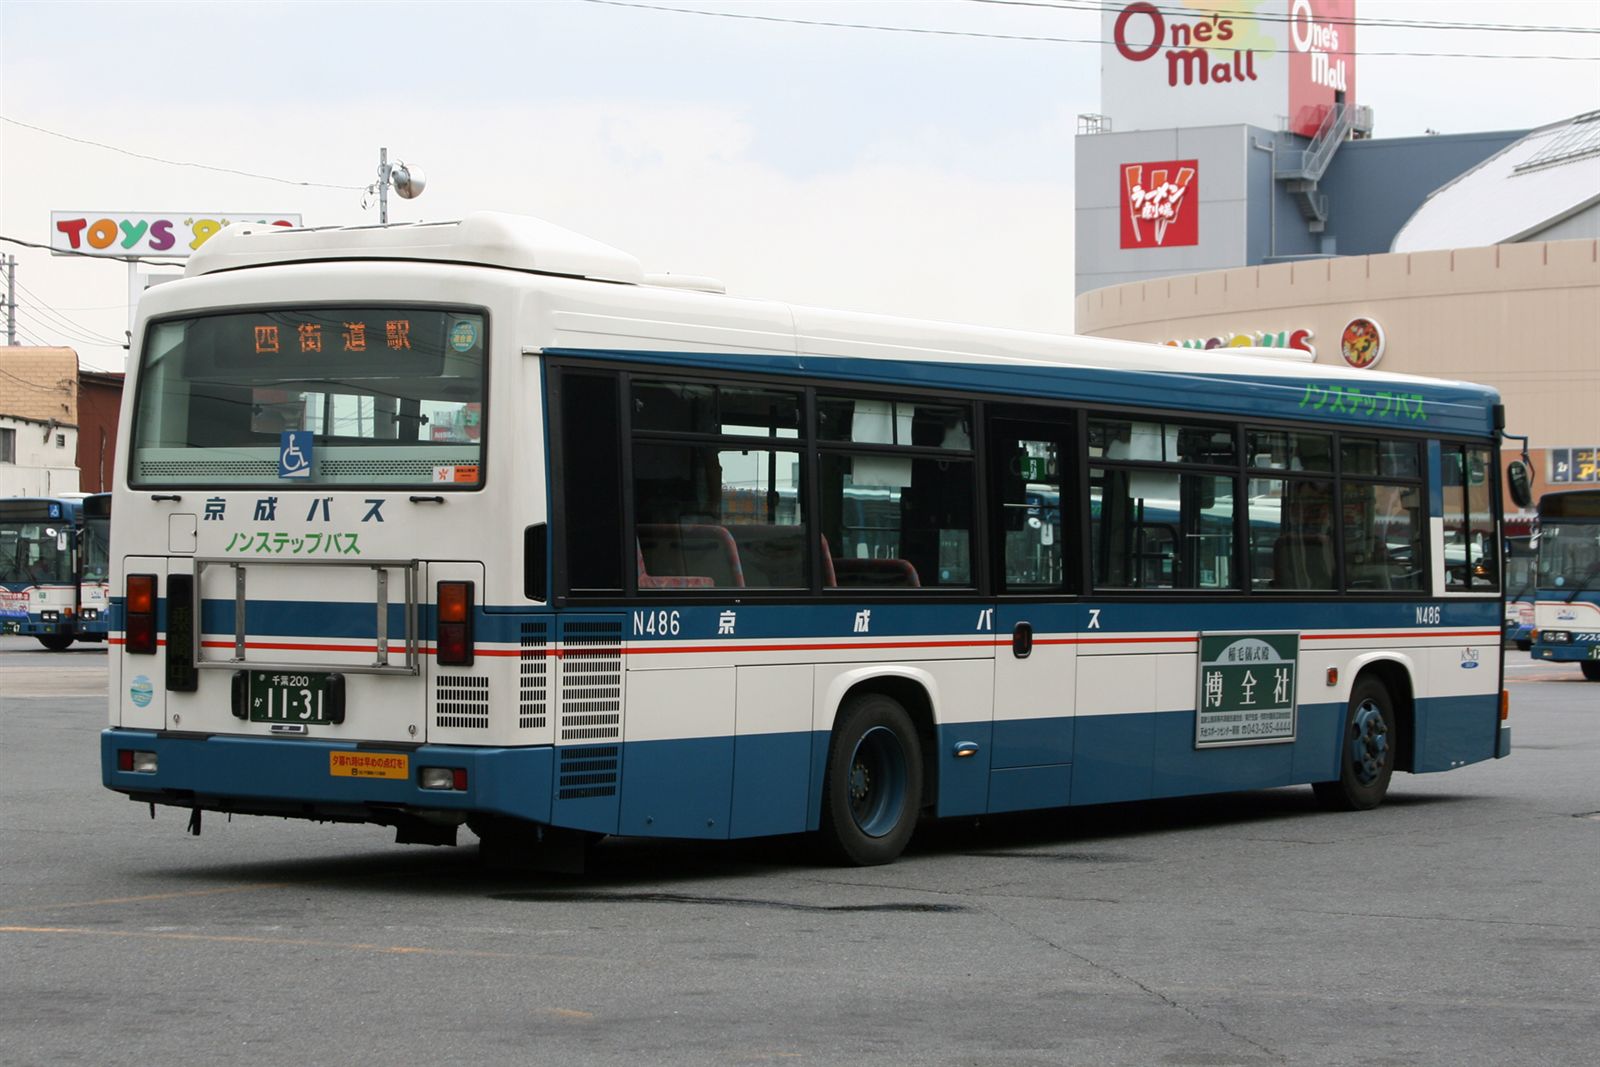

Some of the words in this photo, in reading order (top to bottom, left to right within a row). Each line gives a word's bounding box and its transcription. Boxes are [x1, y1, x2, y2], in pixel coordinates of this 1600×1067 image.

[1114, 2, 1233, 62] One's
[1291, 0, 1338, 53] One's
[1131, 182, 1185, 209] ラーメン
[57, 218, 175, 251] TOYS
[254, 319, 412, 354] 四街道駅
[1299, 384, 1428, 420] ノンステップバス
[204, 497, 386, 523] 京成バス
[225, 532, 361, 555] ノンステップバス
[633, 610, 680, 636] N486
[1416, 606, 1441, 625] N486
[254, 697, 263, 708] か
[1205, 668, 1290, 708] 博全社
